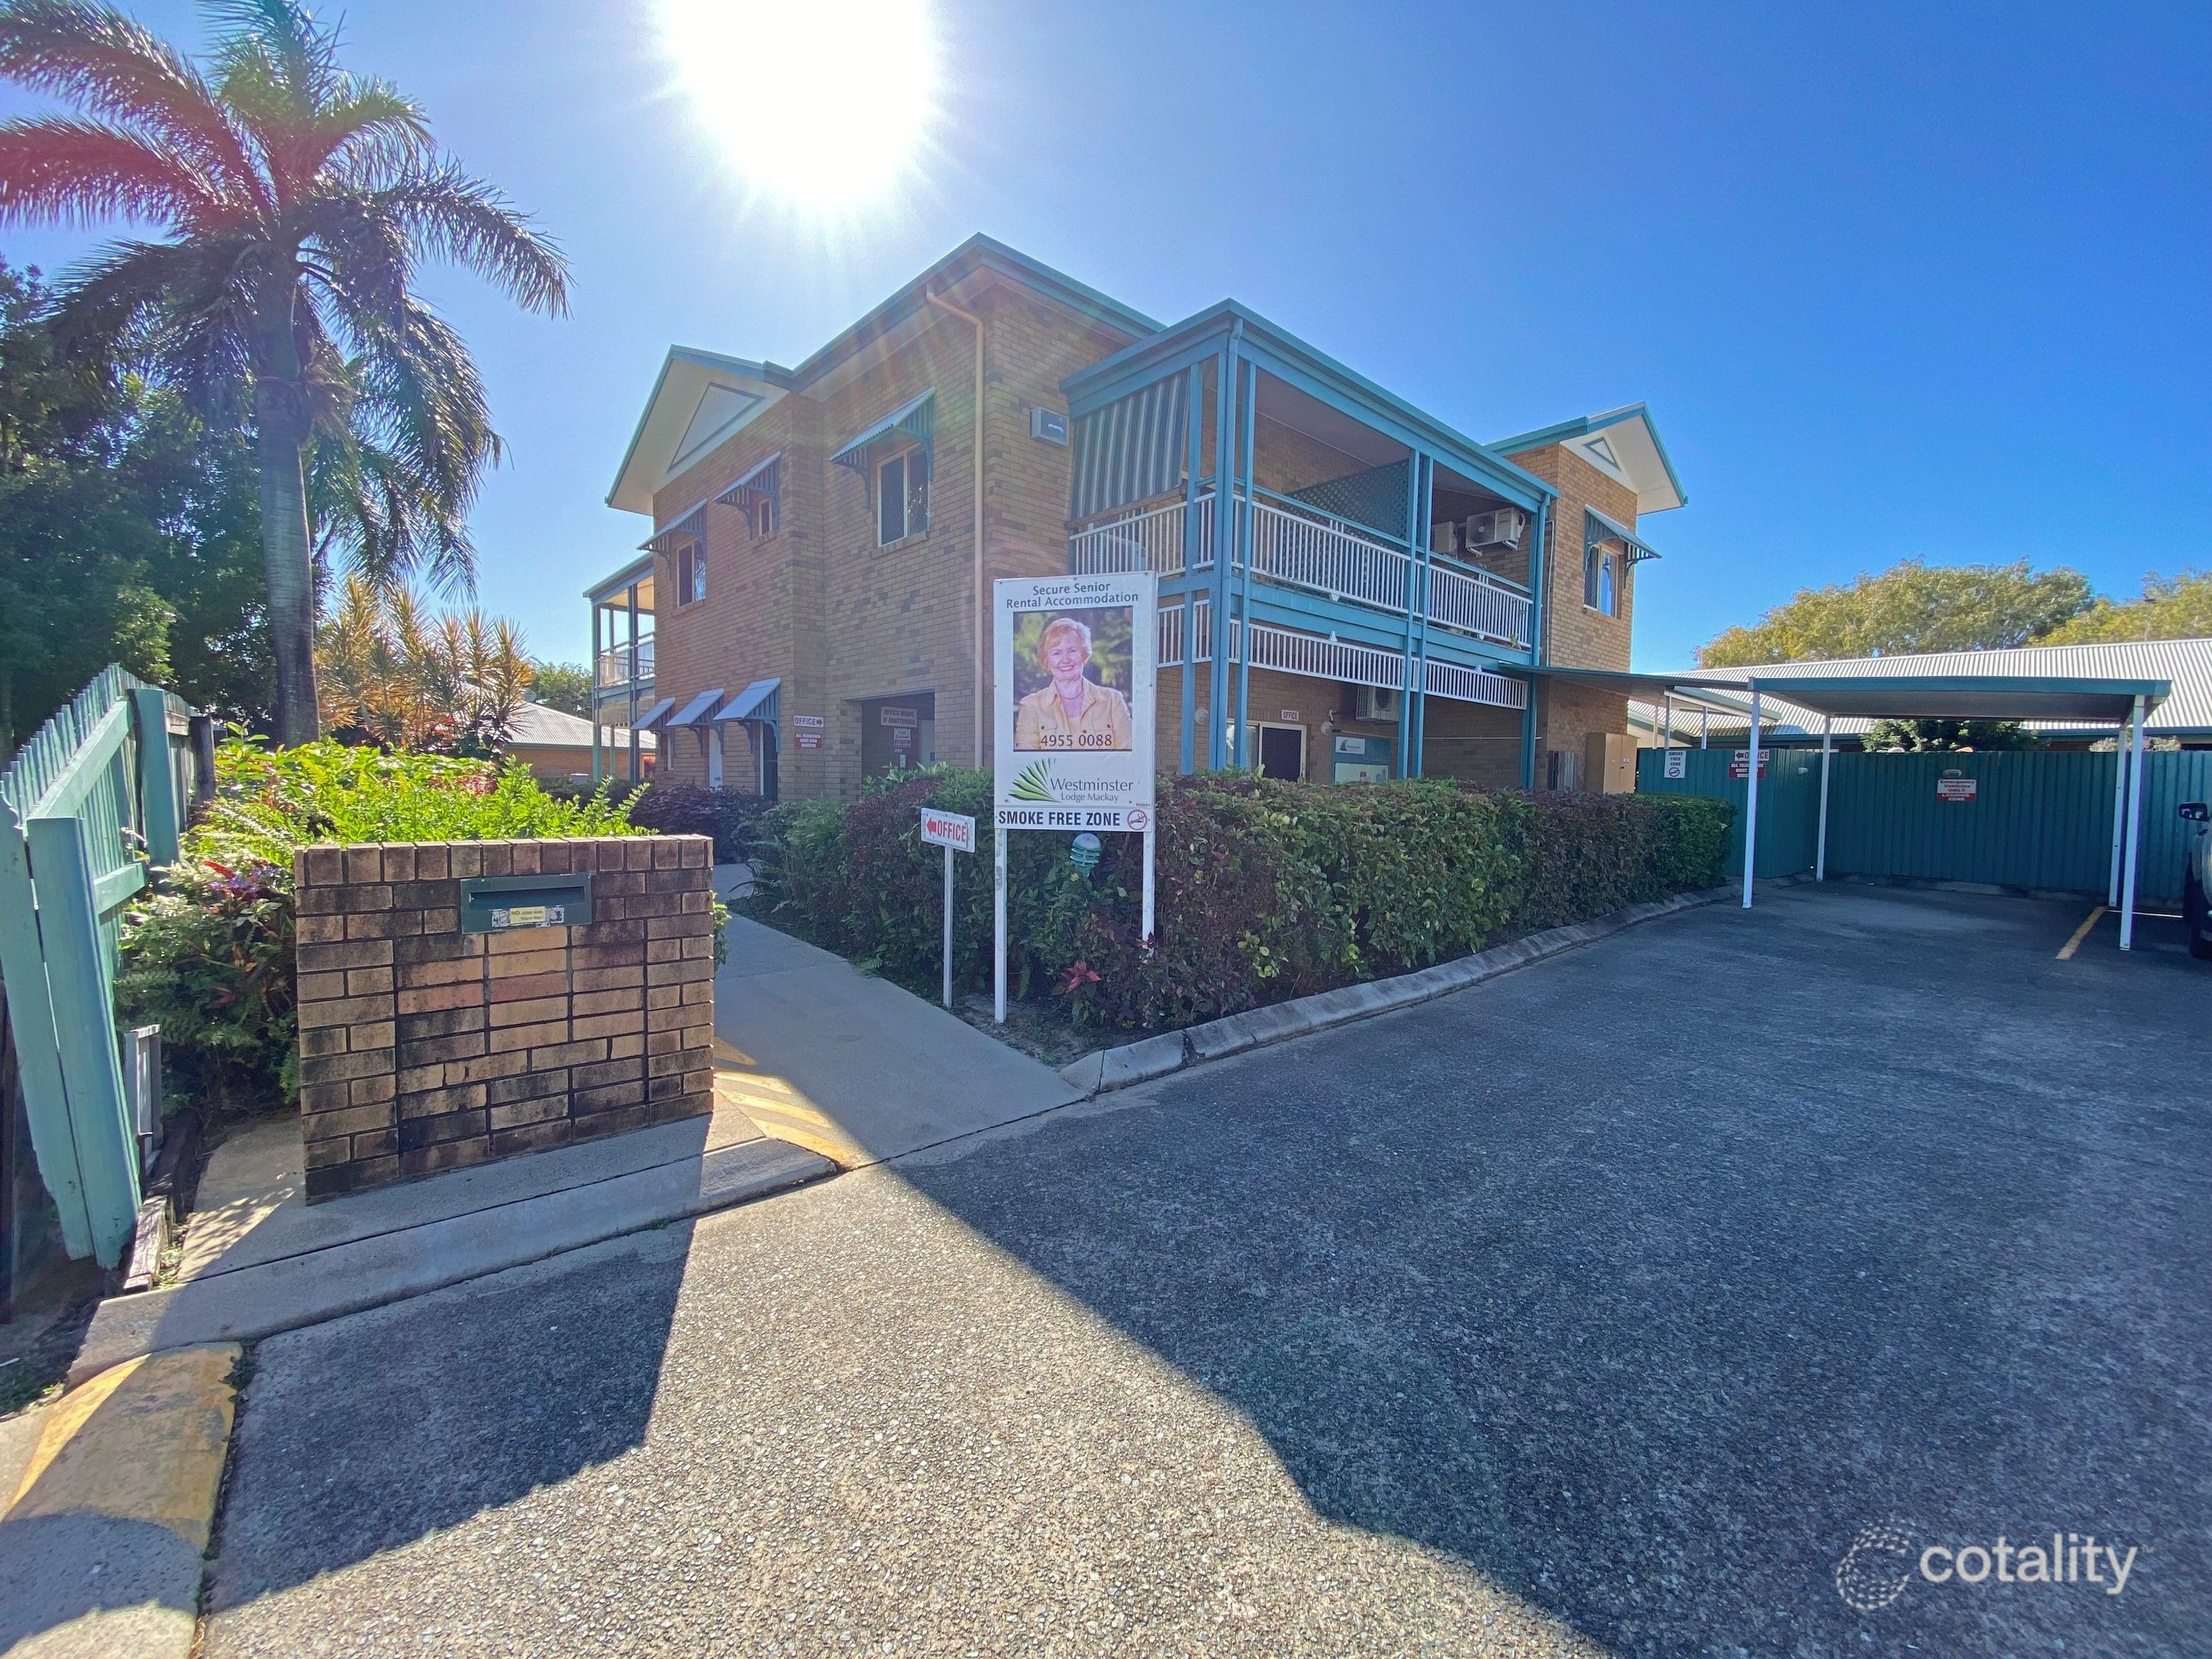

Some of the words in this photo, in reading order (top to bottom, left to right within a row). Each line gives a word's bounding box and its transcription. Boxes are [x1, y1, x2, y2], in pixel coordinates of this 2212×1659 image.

[1033, 585, 1070, 595] Secure
[1074, 582, 1111, 593] Senior
[1006, 597, 1041, 608] Rental
[1045, 592, 1138, 606] Accommodation
[795, 717, 816, 726] OFFICE
[1283, 711, 1298, 720] OFFICE
[1041, 734, 1073, 747] 4955
[1078, 734, 1112, 747] 0088
[1050, 778, 1134, 791] Westminster
[1061, 792, 1085, 803] Lodge
[1088, 793, 1118, 803] Mackay
[998, 810, 1044, 825] SMOKE
[1048, 812, 1081, 826] FREE
[1086, 812, 1121, 826] ZONE
[937, 820, 966, 843] OFFICE
